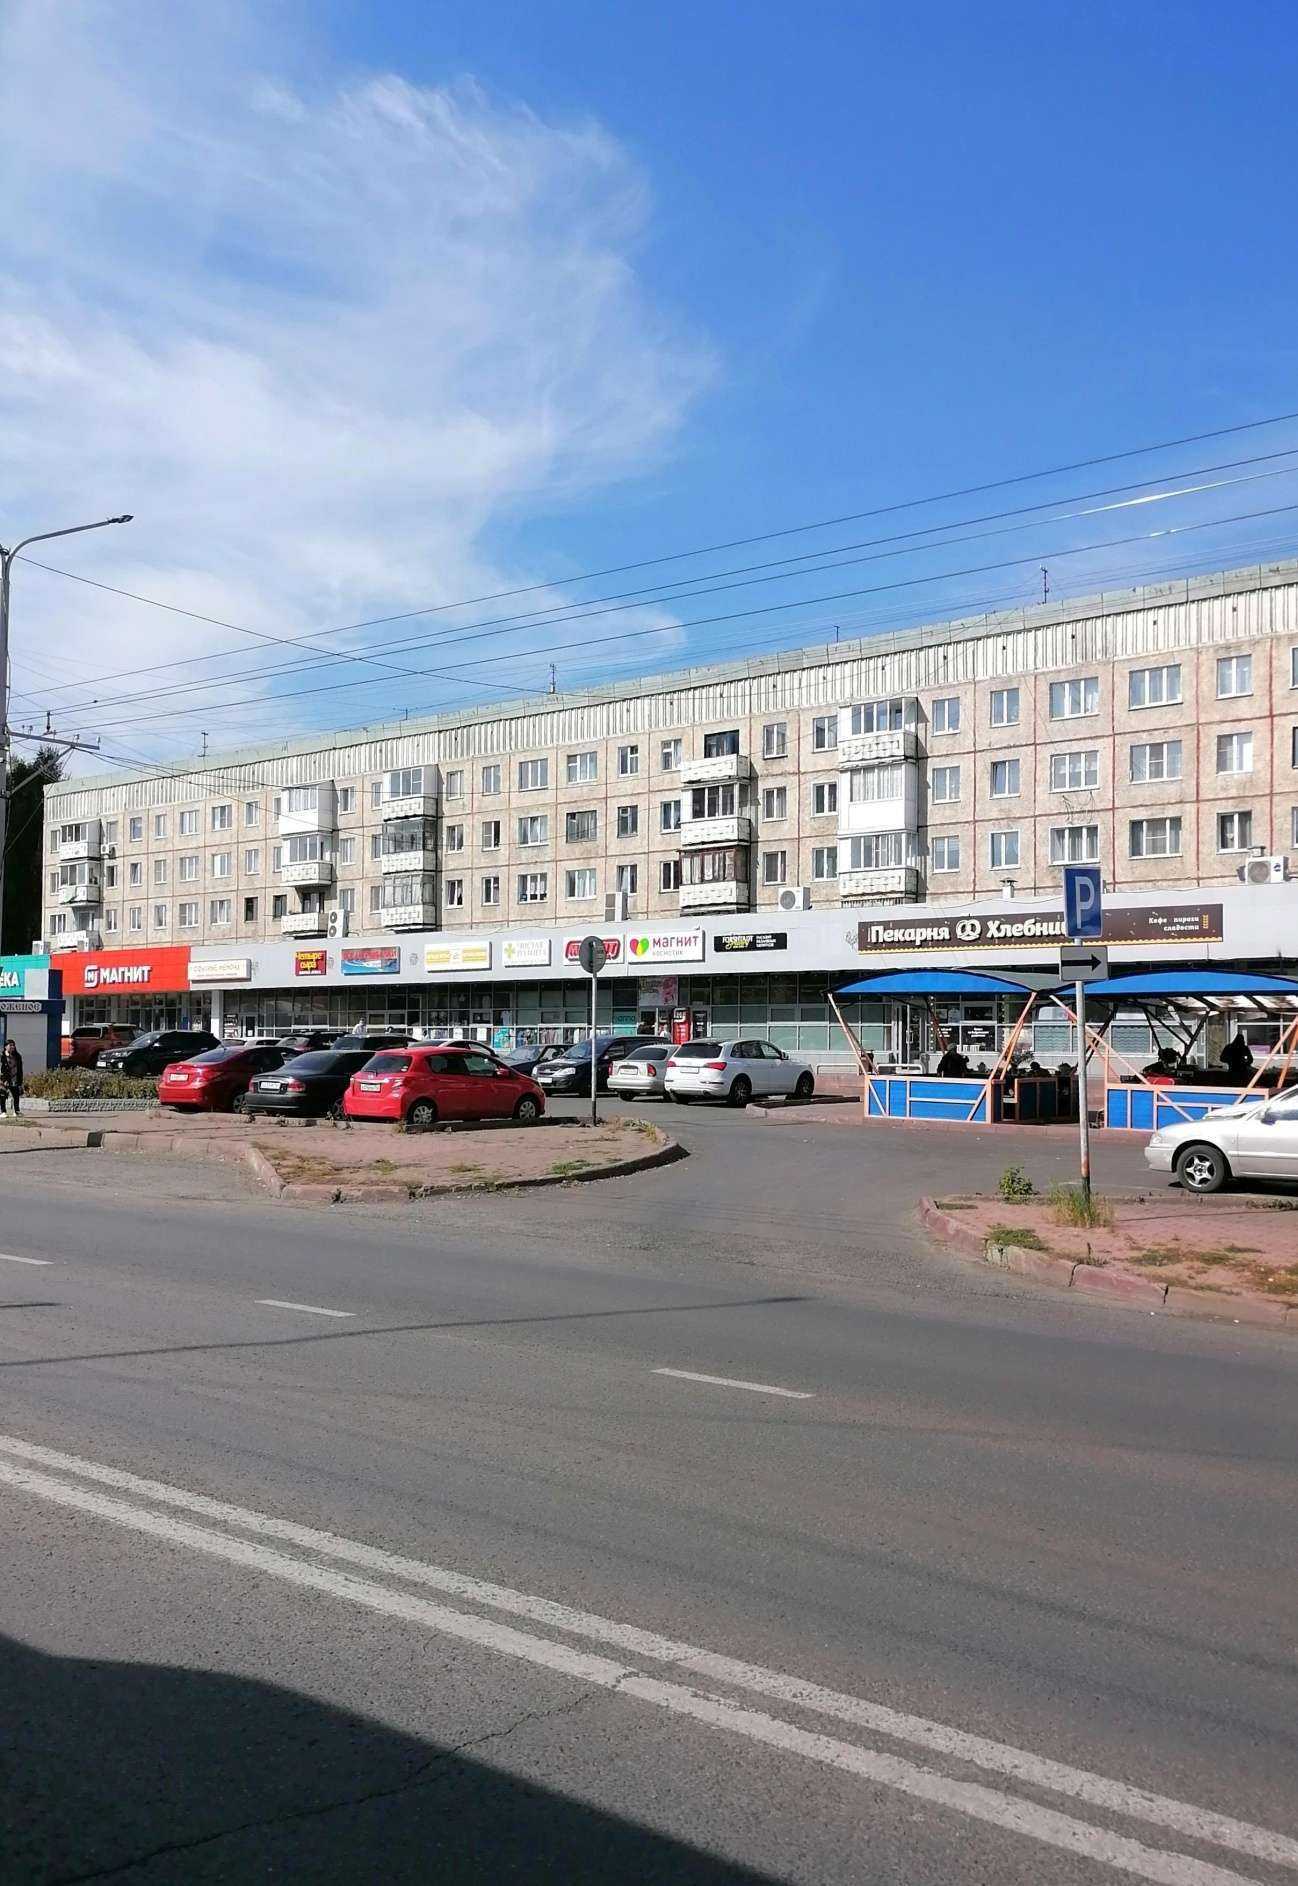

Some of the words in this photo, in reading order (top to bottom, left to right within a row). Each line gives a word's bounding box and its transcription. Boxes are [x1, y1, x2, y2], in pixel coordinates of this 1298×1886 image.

[1075, 876, 1095, 929] P
[652, 935, 700, 948] магнит
[871, 925, 950, 946] Пекарня
[99, 966, 151, 984] МАГНИТ
